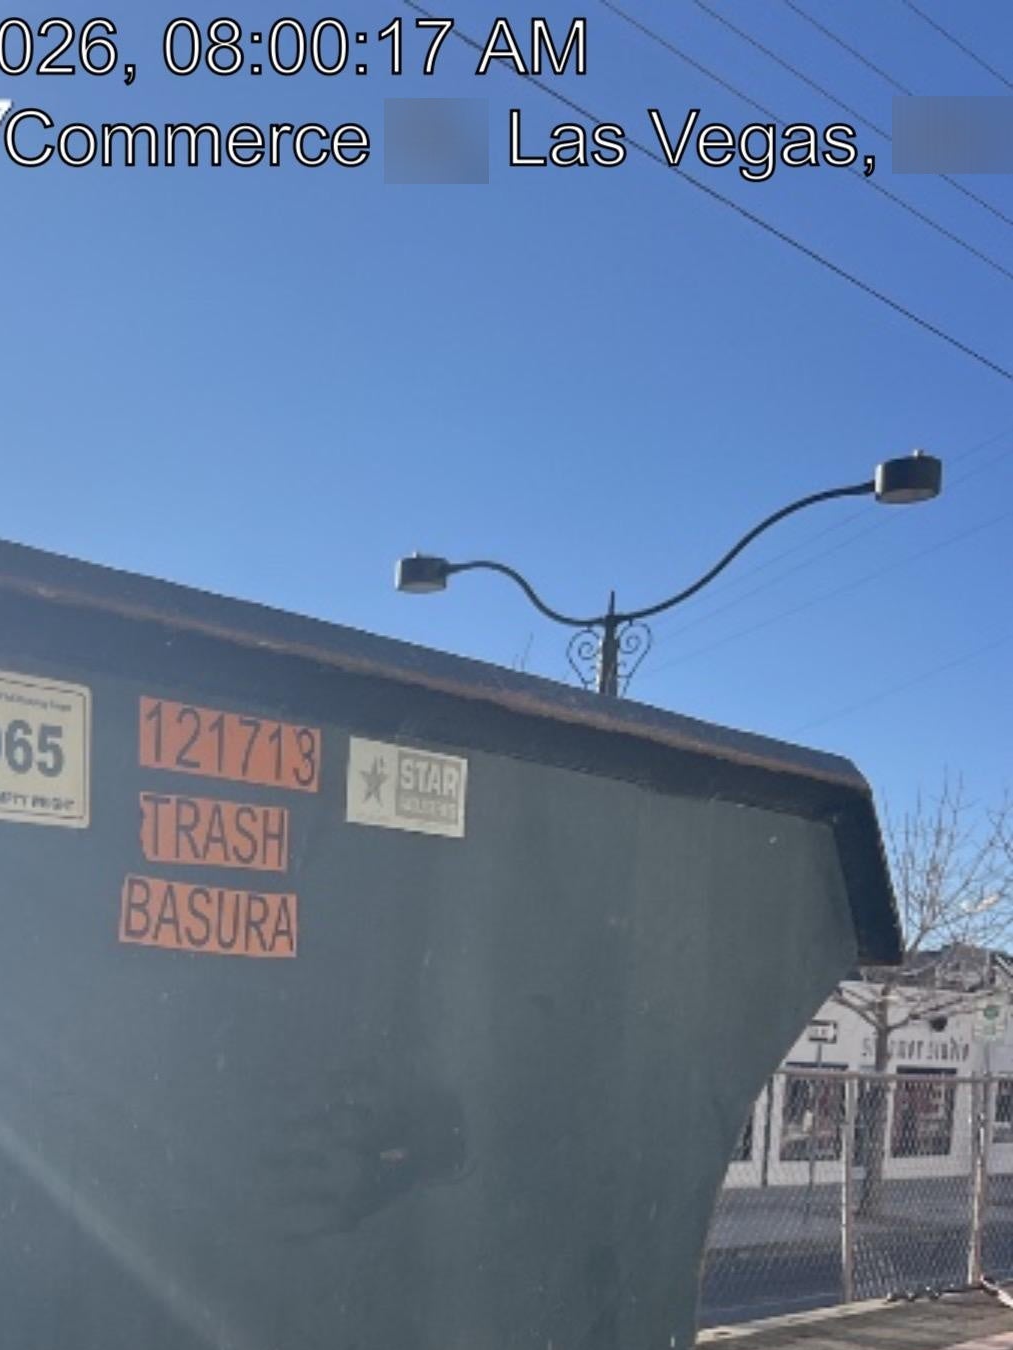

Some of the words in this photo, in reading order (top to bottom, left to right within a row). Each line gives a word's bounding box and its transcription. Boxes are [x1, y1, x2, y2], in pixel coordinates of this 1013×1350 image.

[144, 702, 317, 787] 121713
[400, 759, 460, 798] STAR
[142, 794, 286, 868] TRASH
[124, 876, 295, 954] BASURA
